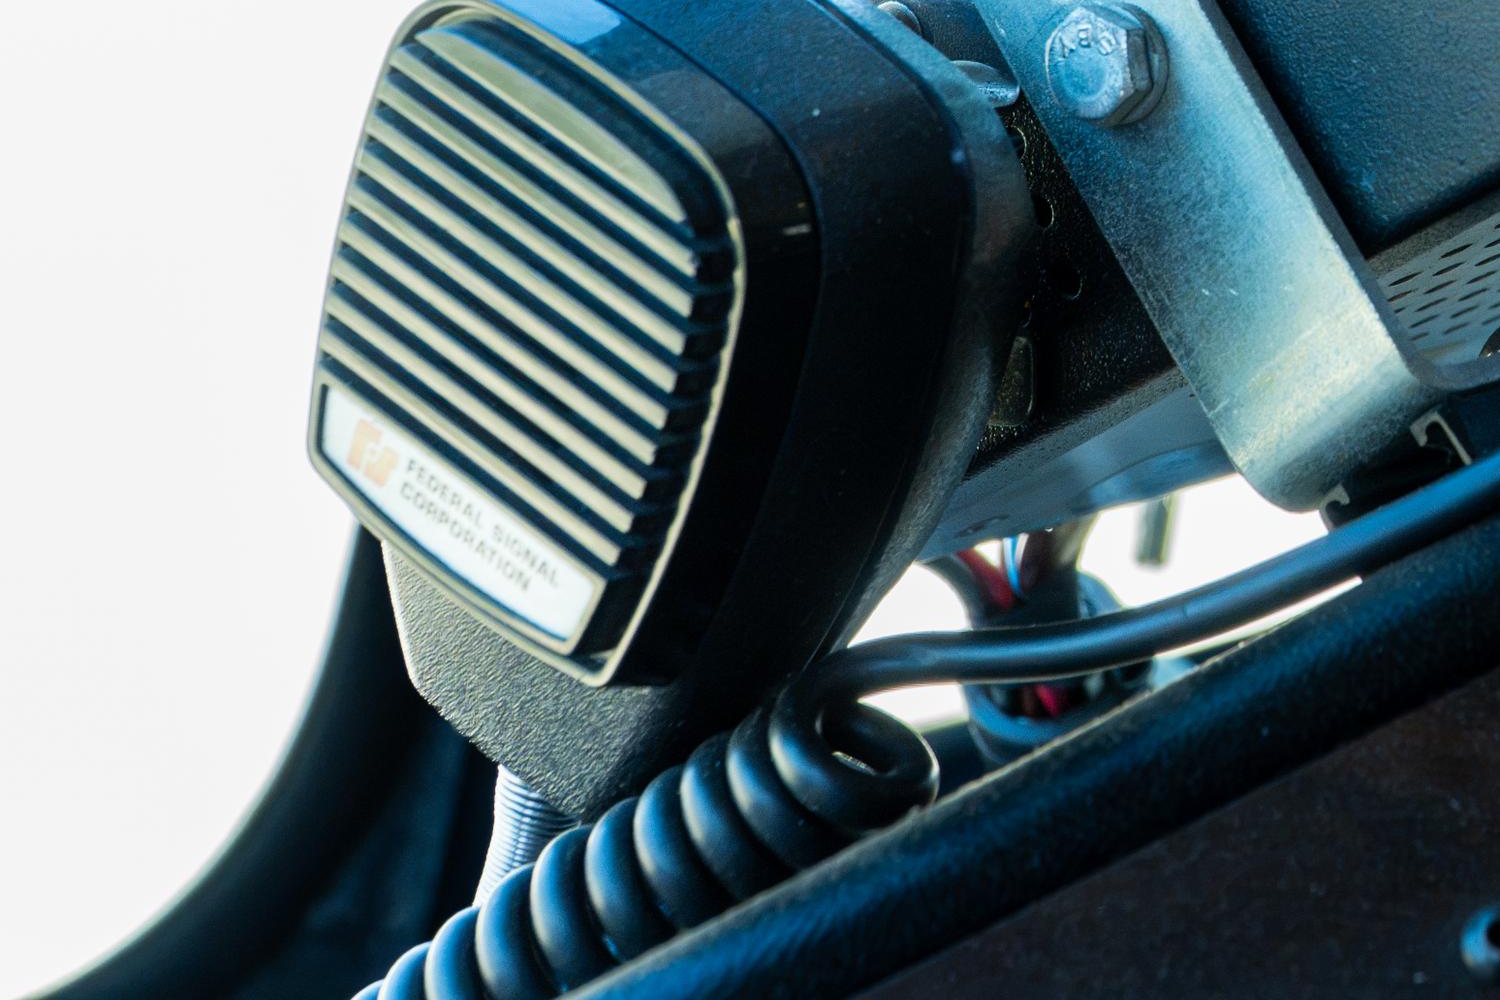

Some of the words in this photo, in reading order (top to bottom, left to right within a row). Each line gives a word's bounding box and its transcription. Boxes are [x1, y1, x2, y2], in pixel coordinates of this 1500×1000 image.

[399, 481, 535, 593] CORPORATION
[405, 457, 485, 529] FEDERAL
[493, 523, 560, 589] SIGNAL
